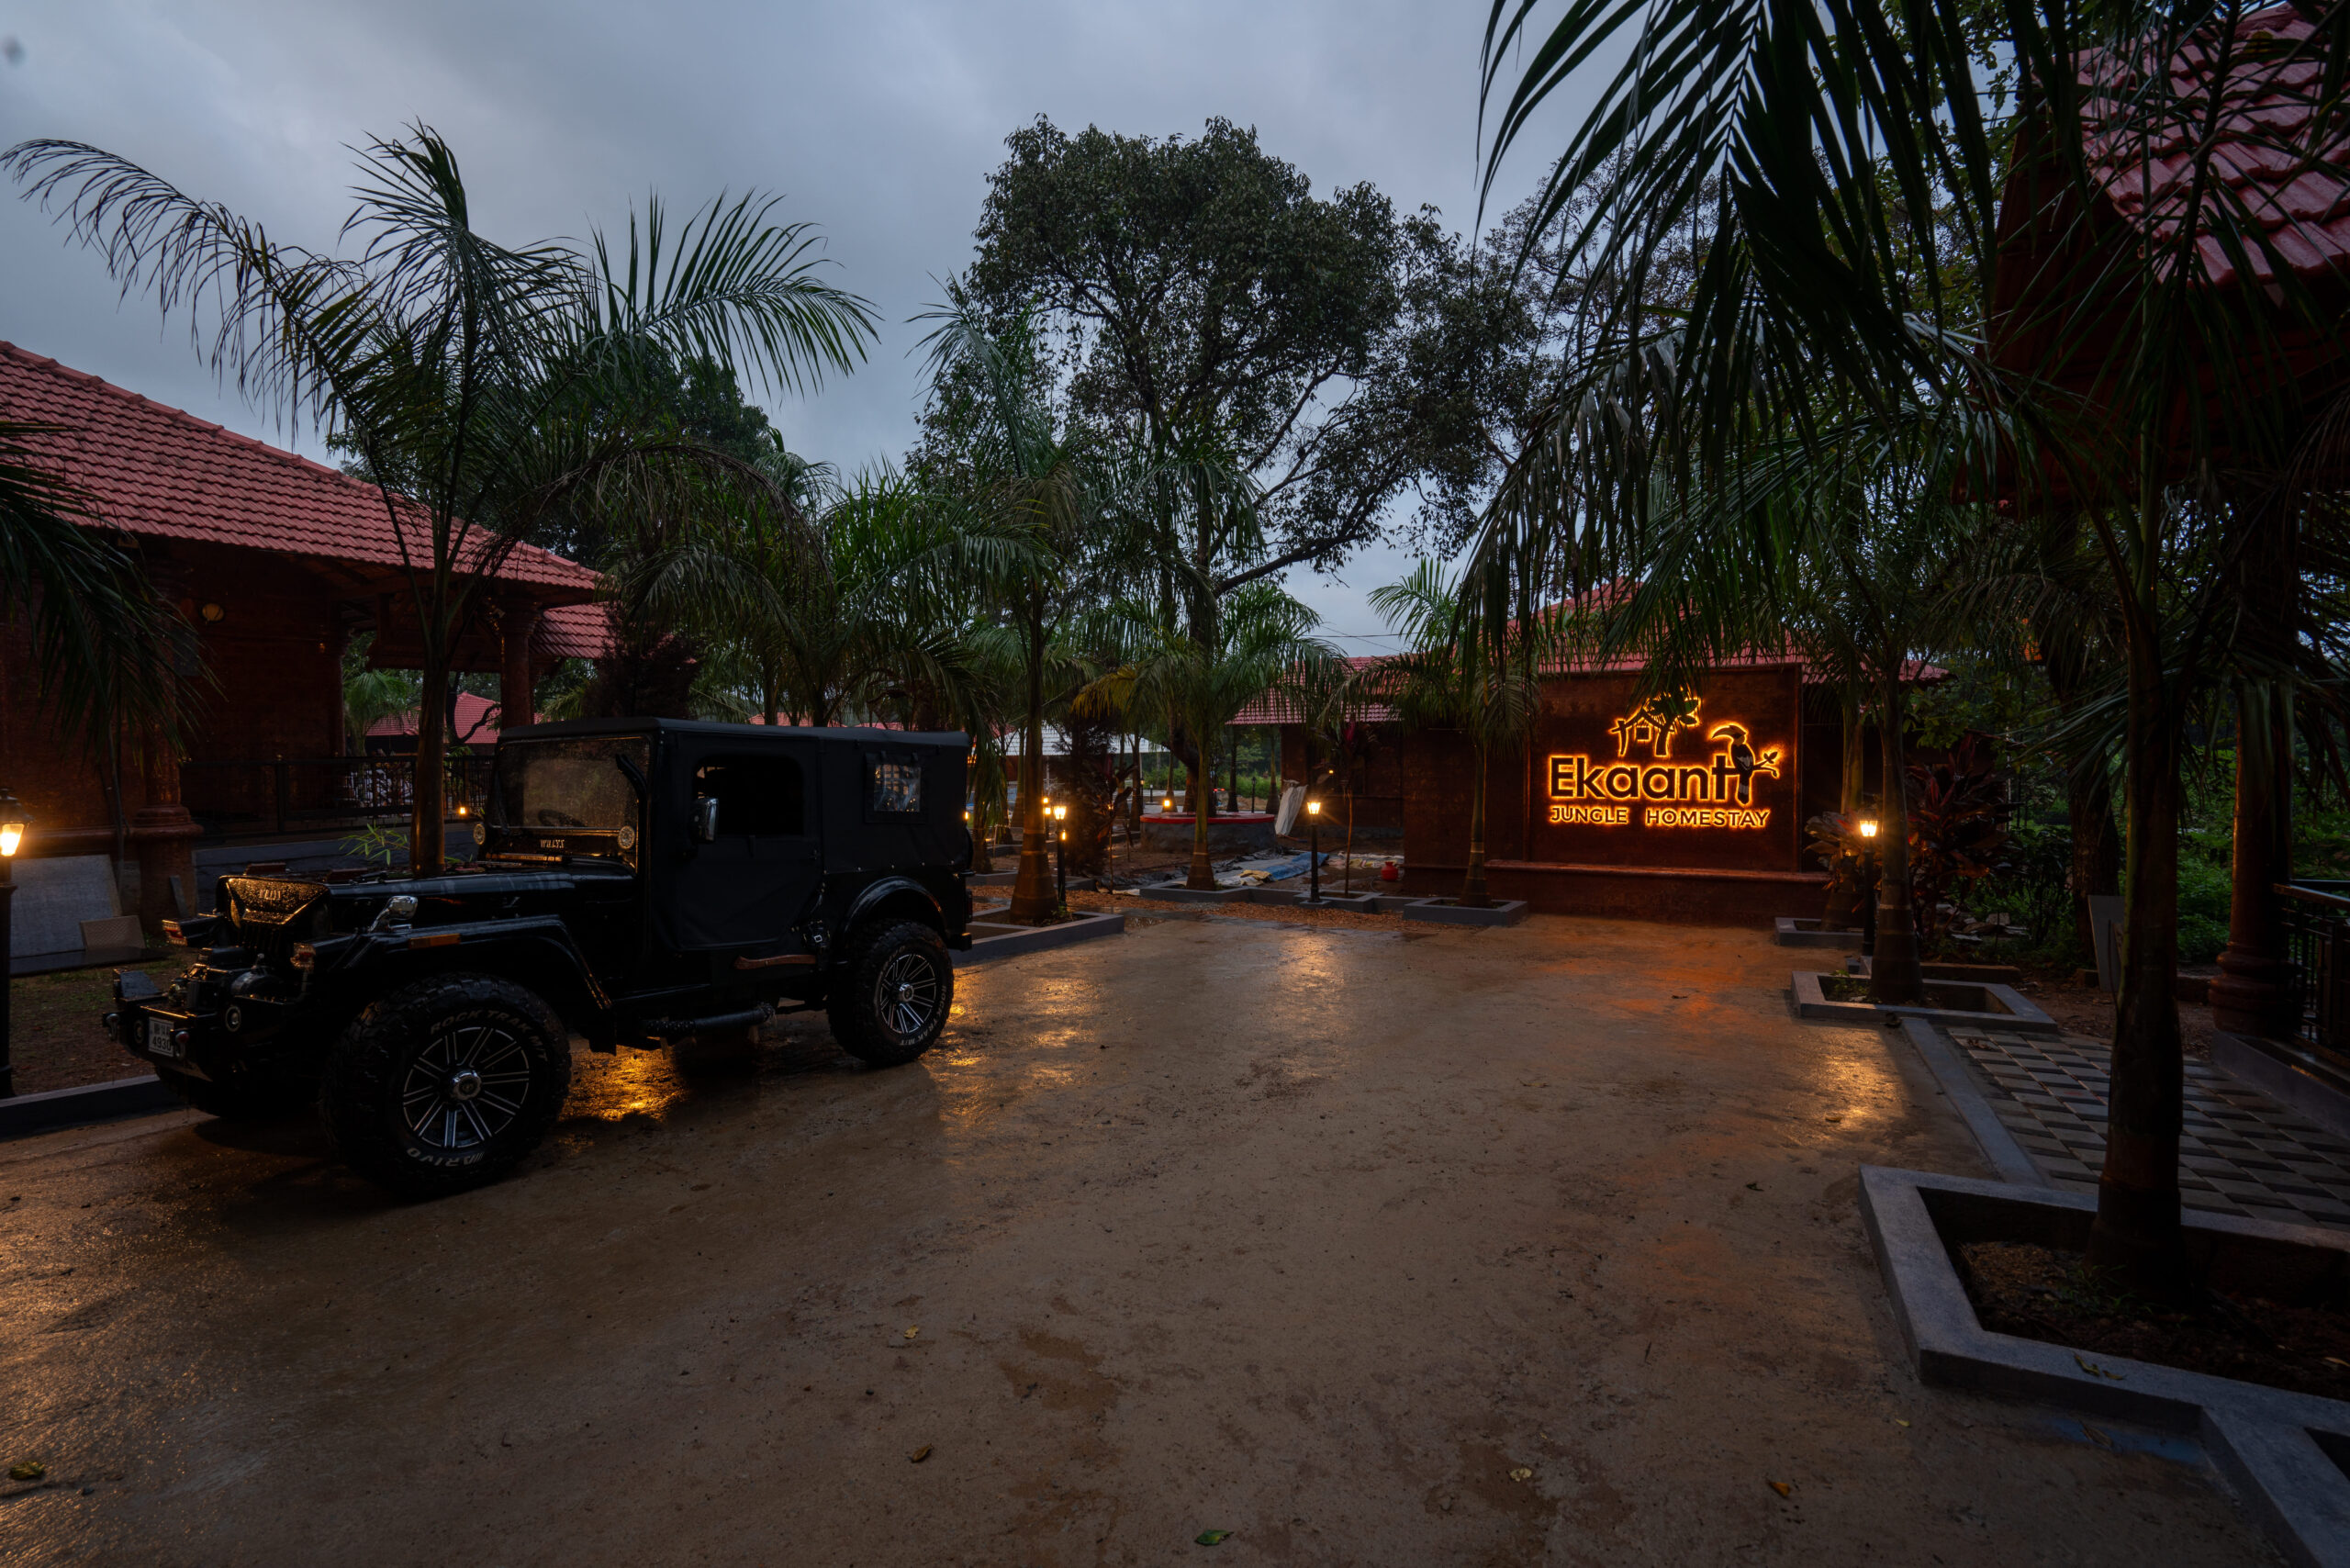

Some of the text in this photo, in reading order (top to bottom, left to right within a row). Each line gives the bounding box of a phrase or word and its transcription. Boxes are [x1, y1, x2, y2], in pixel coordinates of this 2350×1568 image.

[1550, 755, 1738, 801] Ekaant
[1550, 807, 1770, 826] JUNGLE HOMESTAY
[406, 1147, 481, 1167] ARIVO
